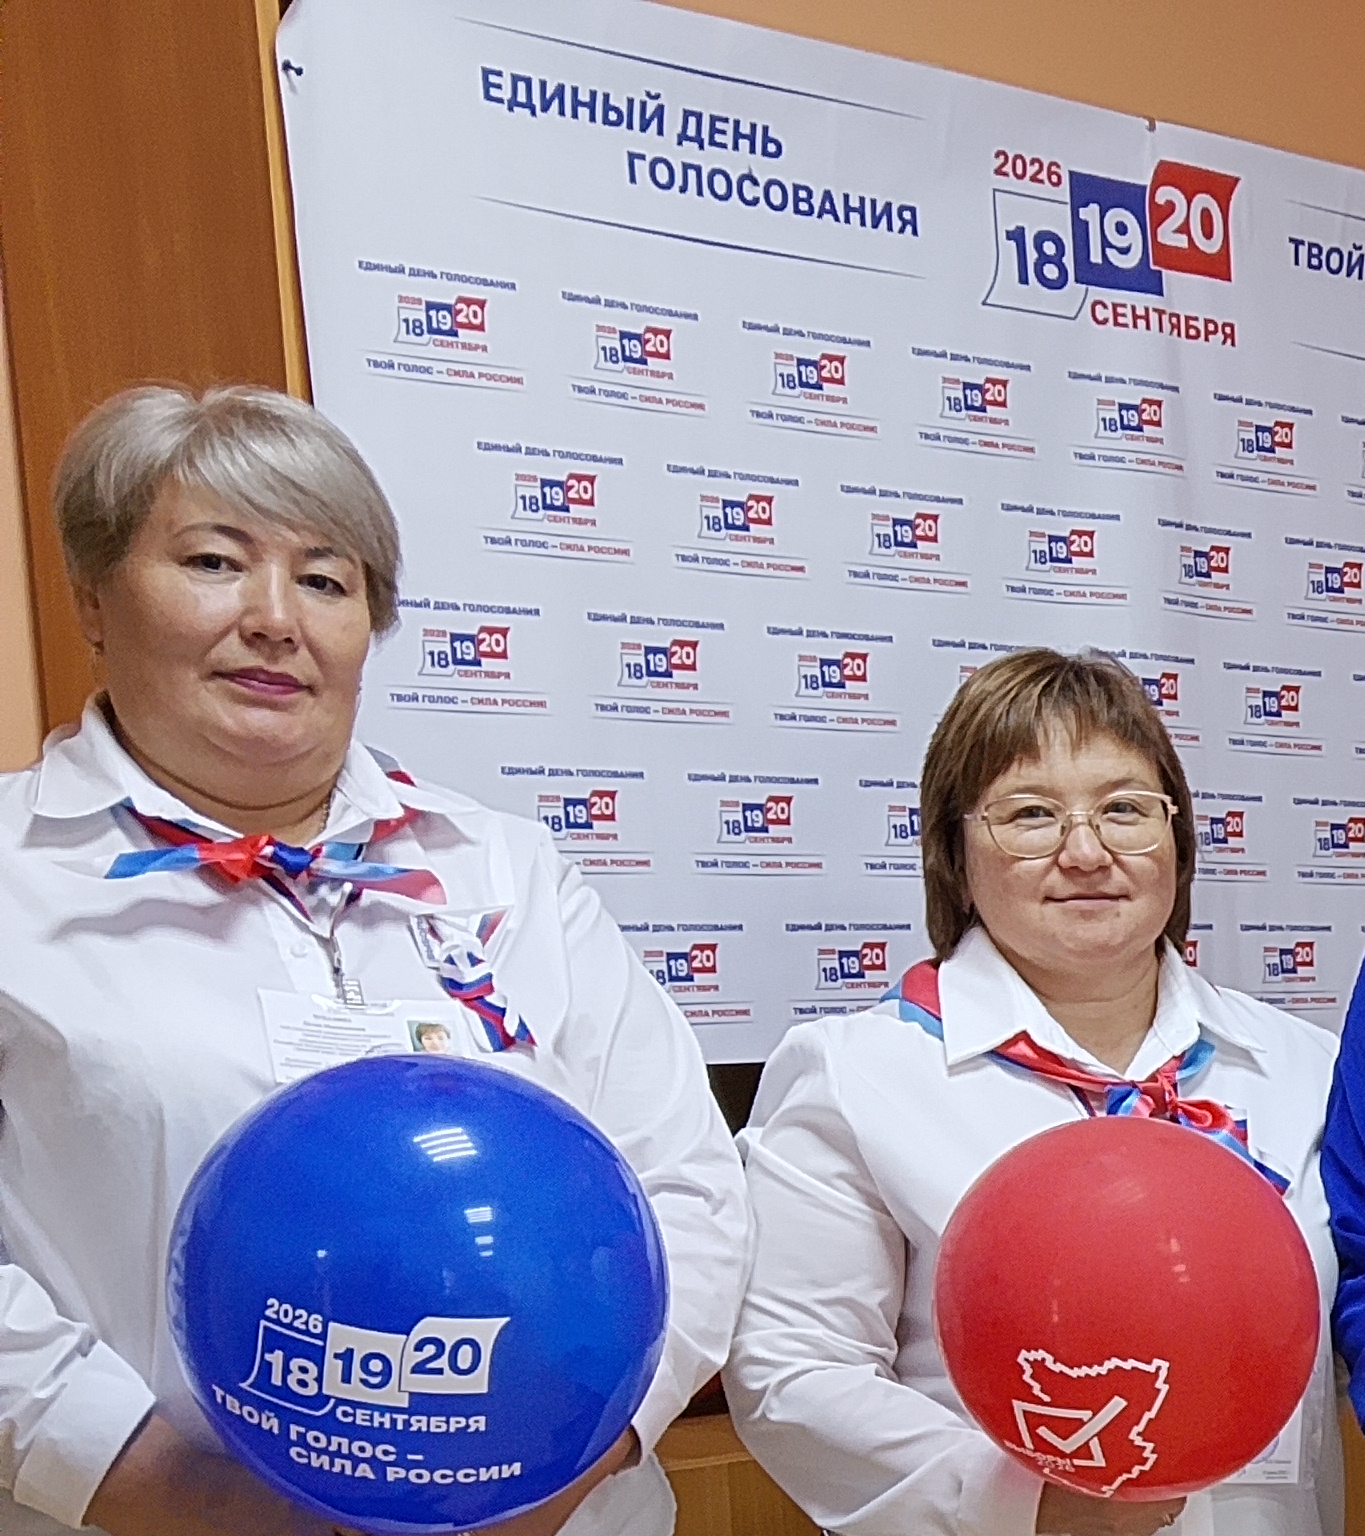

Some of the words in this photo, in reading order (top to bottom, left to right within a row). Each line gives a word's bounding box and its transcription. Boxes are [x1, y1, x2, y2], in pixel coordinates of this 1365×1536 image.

[481, 66, 665, 137] ЕДИНЫЙ
[677, 108, 782, 159] ДЕНЬ
[993, 150, 1063, 187] 2026
[627, 151, 919, 237] ГОЛОСОВАНИЯ
[1005, 226, 1068, 290] 18
[1079, 203, 1143, 269] 19
[1154, 185, 1224, 255] 20
[1289, 237, 1365, 280] ТВОЙ
[358, 260, 405, 274] ЕДИНЫЙ
[408, 267, 437, 279] ДЕНЬ
[440, 271, 517, 291] ГОЛОСОВАНИЯ
[402, 318, 424, 336] 18
[428, 310, 451, 329] 19
[455, 303, 482, 324] 20
[1090, 299, 1236, 347] СЕНТЯБРЯ
[432, 339, 488, 353] СЕНТЯБРЯ
[601, 346, 619, 364] 18
[622, 338, 641, 358] 19
[645, 333, 668, 353] 20
[366, 358, 395, 370] ТВОЙ
[398, 362, 433, 375] ГОЛОС
[446, 368, 475, 379] СИЛА
[779, 372, 796, 389] 18
[800, 365, 817, 383] 19
[820, 359, 842, 378] 20
[946, 396, 962, 412] 18
[965, 389, 981, 406] 19
[984, 383, 1005, 402] 20
[1101, 417, 1118, 432] 18
[1121, 410, 1139, 426] 19
[1142, 405, 1160, 421] 20
[519, 494, 540, 513] 18
[543, 486, 563, 506] 19
[567, 480, 592, 499] 20
[704, 514, 722, 532] 18
[725, 506, 744, 526] 19
[747, 501, 770, 519] 20
[1032, 549, 1047, 565] 18
[1050, 542, 1067, 559] 19
[1070, 536, 1092, 552] 20
[1310, 579, 1324, 594] 18
[1326, 573, 1341, 588] 19
[1343, 568, 1360, 583] 20
[428, 651, 449, 668] 18
[453, 641, 475, 660] 19
[478, 632, 505, 653] 20
[625, 663, 643, 680] 18
[647, 654, 666, 672] 19
[671, 646, 694, 665] 20
[802, 674, 819, 690] 18
[822, 665, 840, 682] 19
[844, 658, 864, 676] 20
[1248, 704, 1262, 719] 18
[1264, 697, 1278, 712] 19
[1281, 691, 1298, 706] 20
[724, 819, 741, 836] 18
[745, 809, 763, 827] 19
[767, 802, 789, 819] 20
[264, 1297, 323, 1334] 2026
[264, 1349, 319, 1397] 18
[333, 1346, 393, 1390] 19
[409, 1336, 482, 1377] 20
[211, 1384, 280, 1435] ТВОЙ
[289, 1423, 397, 1461] ГОЛОС
[335, 1405, 487, 1433] СЕНТЯБРЯ
[289, 1446, 376, 1480] СИЛА
[386, 1461, 522, 1485] РОССИИ
